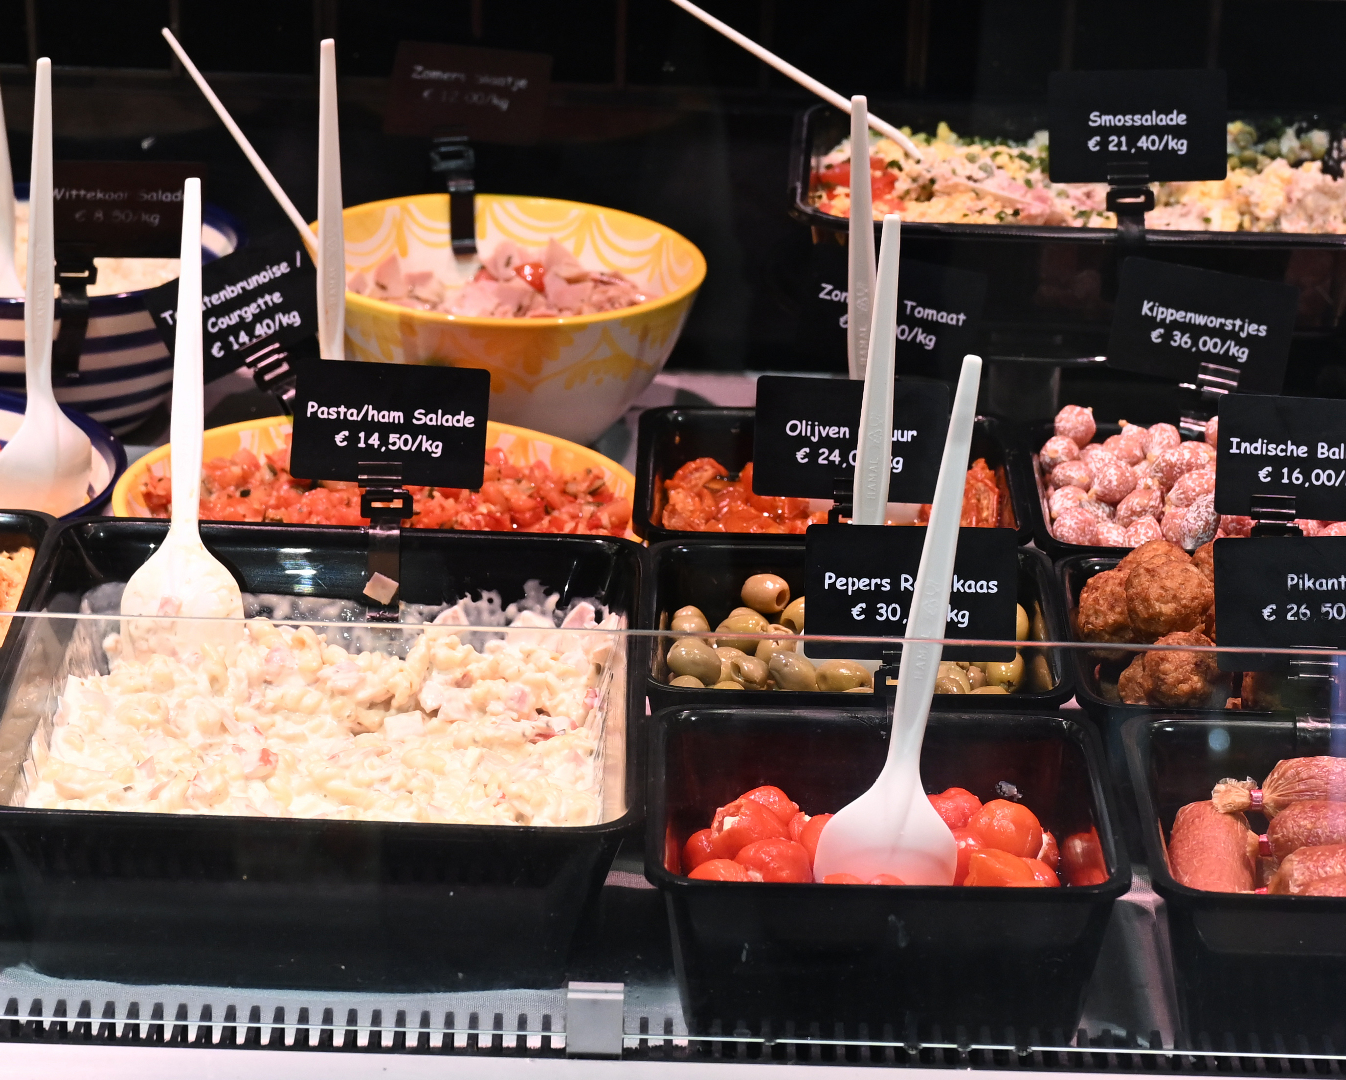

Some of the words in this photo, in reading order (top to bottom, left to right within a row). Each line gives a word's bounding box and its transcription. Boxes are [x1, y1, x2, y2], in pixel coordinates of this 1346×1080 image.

[1088, 109, 1187, 127] Smossalade
[1087, 136, 1100, 152] €
[1108, 134, 1188, 155] 21,40/kg
[138, 187, 186, 202] Salad
[160, 261, 291, 327] Ttenbrunoise
[207, 290, 284, 334] Courgette
[903, 299, 967, 327] Tomaat
[1141, 300, 1267, 338] Kippenworstjes
[211, 341, 225, 358] €
[1150, 328, 1164, 344] €
[1170, 330, 1249, 363] 36,00/kg
[306, 401, 404, 424] Pasta/ham
[412, 408, 475, 428] Salade
[785, 419, 850, 443] Olijven
[334, 430, 349, 447] €
[357, 431, 443, 458] 14,50/kg
[1229, 437, 1309, 458] Indische
[796, 447, 810, 464] €
[1258, 466, 1273, 483] €
[824, 571, 891, 596] Pepers
[900, 573, 999, 594] Rkaas
[851, 602, 867, 621] €
[1261, 603, 1277, 622] €
